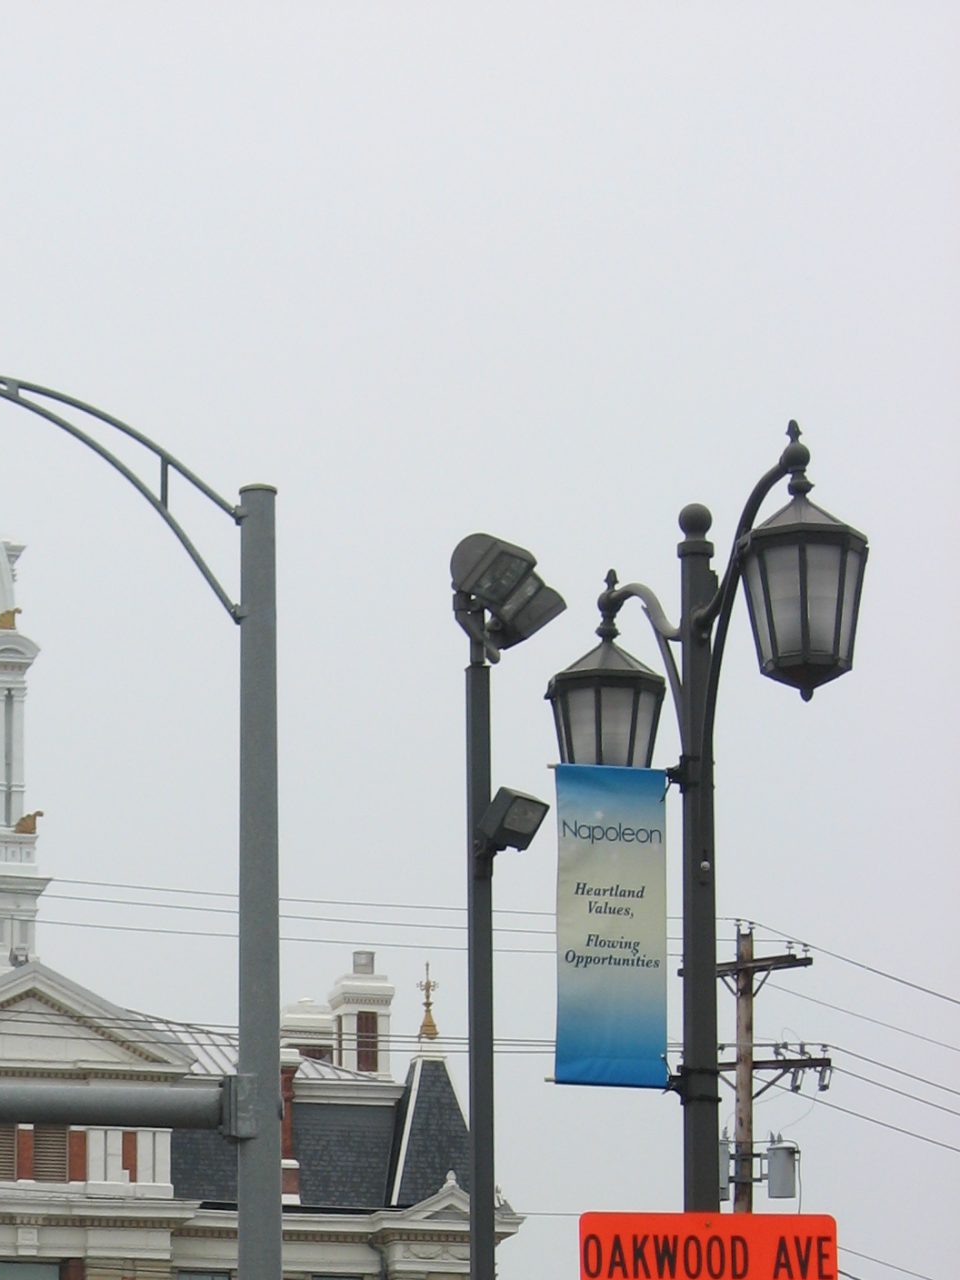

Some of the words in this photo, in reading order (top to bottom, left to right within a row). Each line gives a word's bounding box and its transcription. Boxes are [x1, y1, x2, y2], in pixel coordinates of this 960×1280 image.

[562, 819, 662, 844] Napoleon
[574, 882, 646, 899] Heartland
[587, 900, 635, 918] Values,
[585, 933, 640, 955] Flowing
[564, 949, 661, 969] Opportunities
[583, 1233, 750, 1280] OAKWOOD
[772, 1235, 834, 1280] AVE
